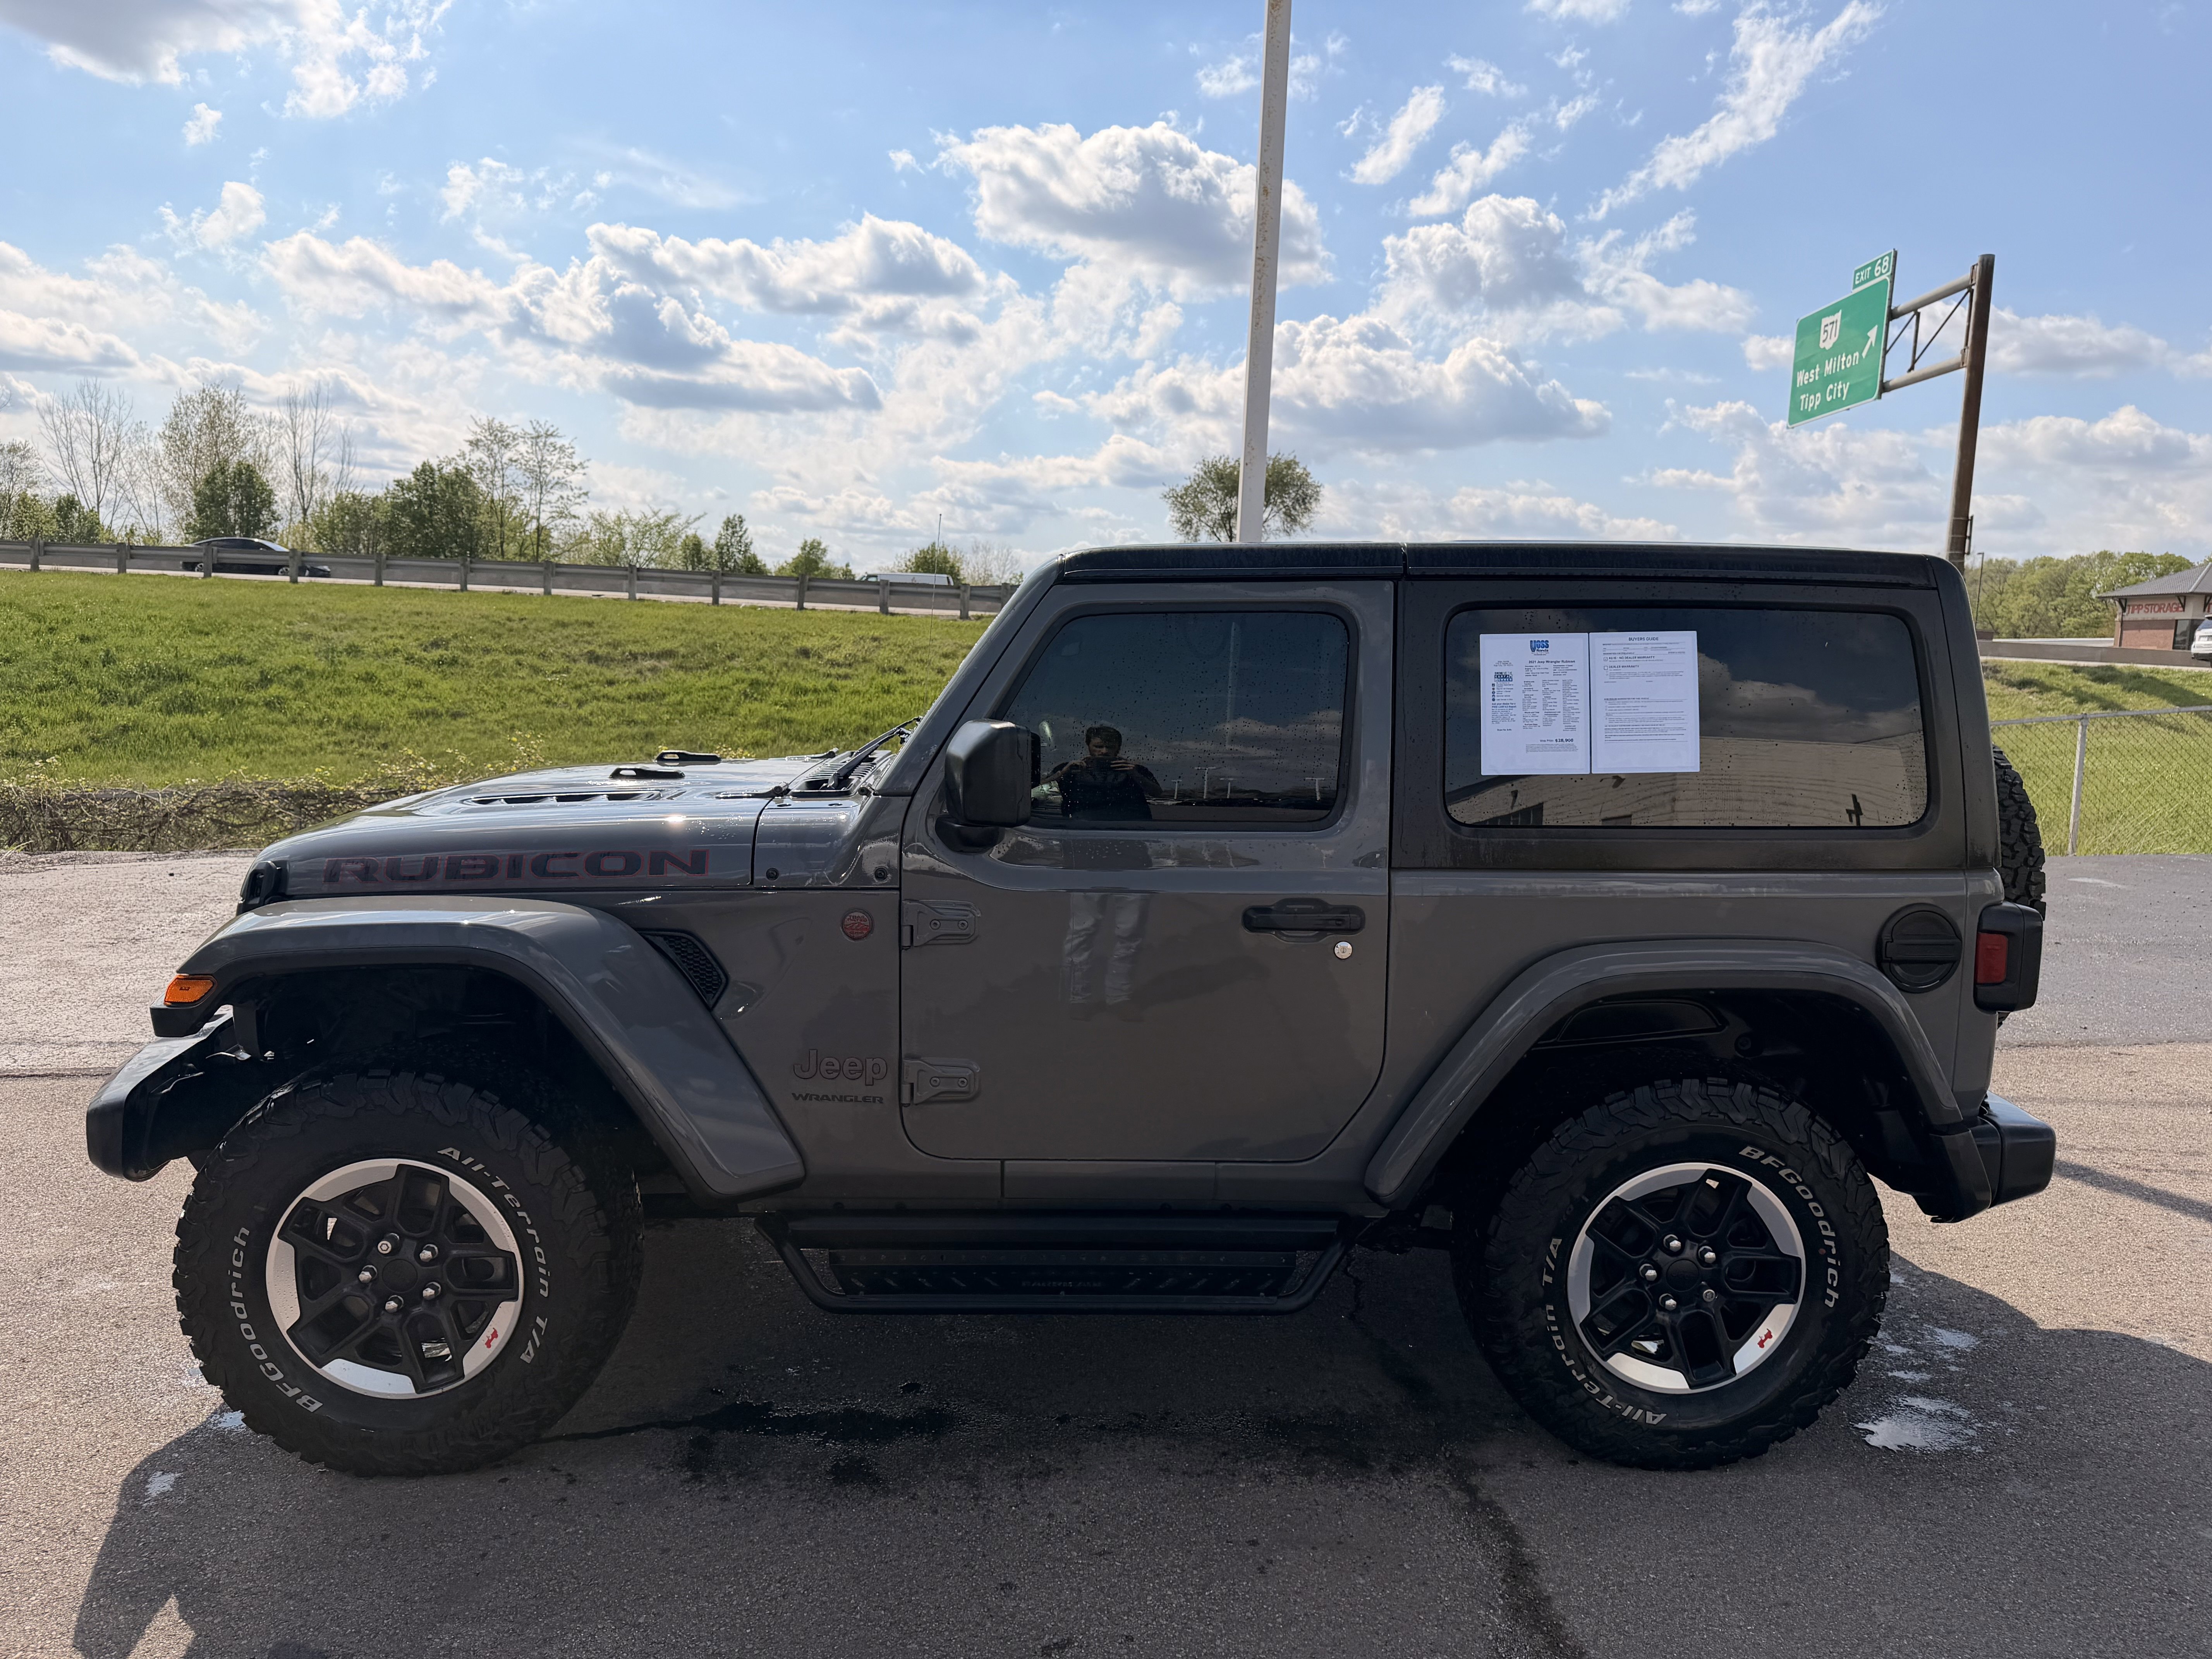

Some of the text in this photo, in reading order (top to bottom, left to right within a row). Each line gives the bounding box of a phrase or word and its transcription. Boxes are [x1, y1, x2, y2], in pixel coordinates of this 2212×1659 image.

[1855, 256, 1889, 285] EXIT 68
[1822, 319, 1838, 343] 571
[1797, 351, 1859, 387] West Milton
[1800, 381, 1850, 412] Tipp City
[2126, 602, 2184, 616] TIPP STORAGE
[1530, 640, 1549, 652] VOSS
[322, 849, 710, 884] RUBICON
[793, 1049, 888, 1086] Jeep
[792, 1092, 883, 1104] WRANGLER
[1738, 1145, 1841, 1309] BFGoodrich
[437, 1146, 550, 1364] All-Terrain T/A
[228, 1226, 323, 1413] BFGoodrich
[1542, 1237, 1668, 1426] All-Terrain T/A
